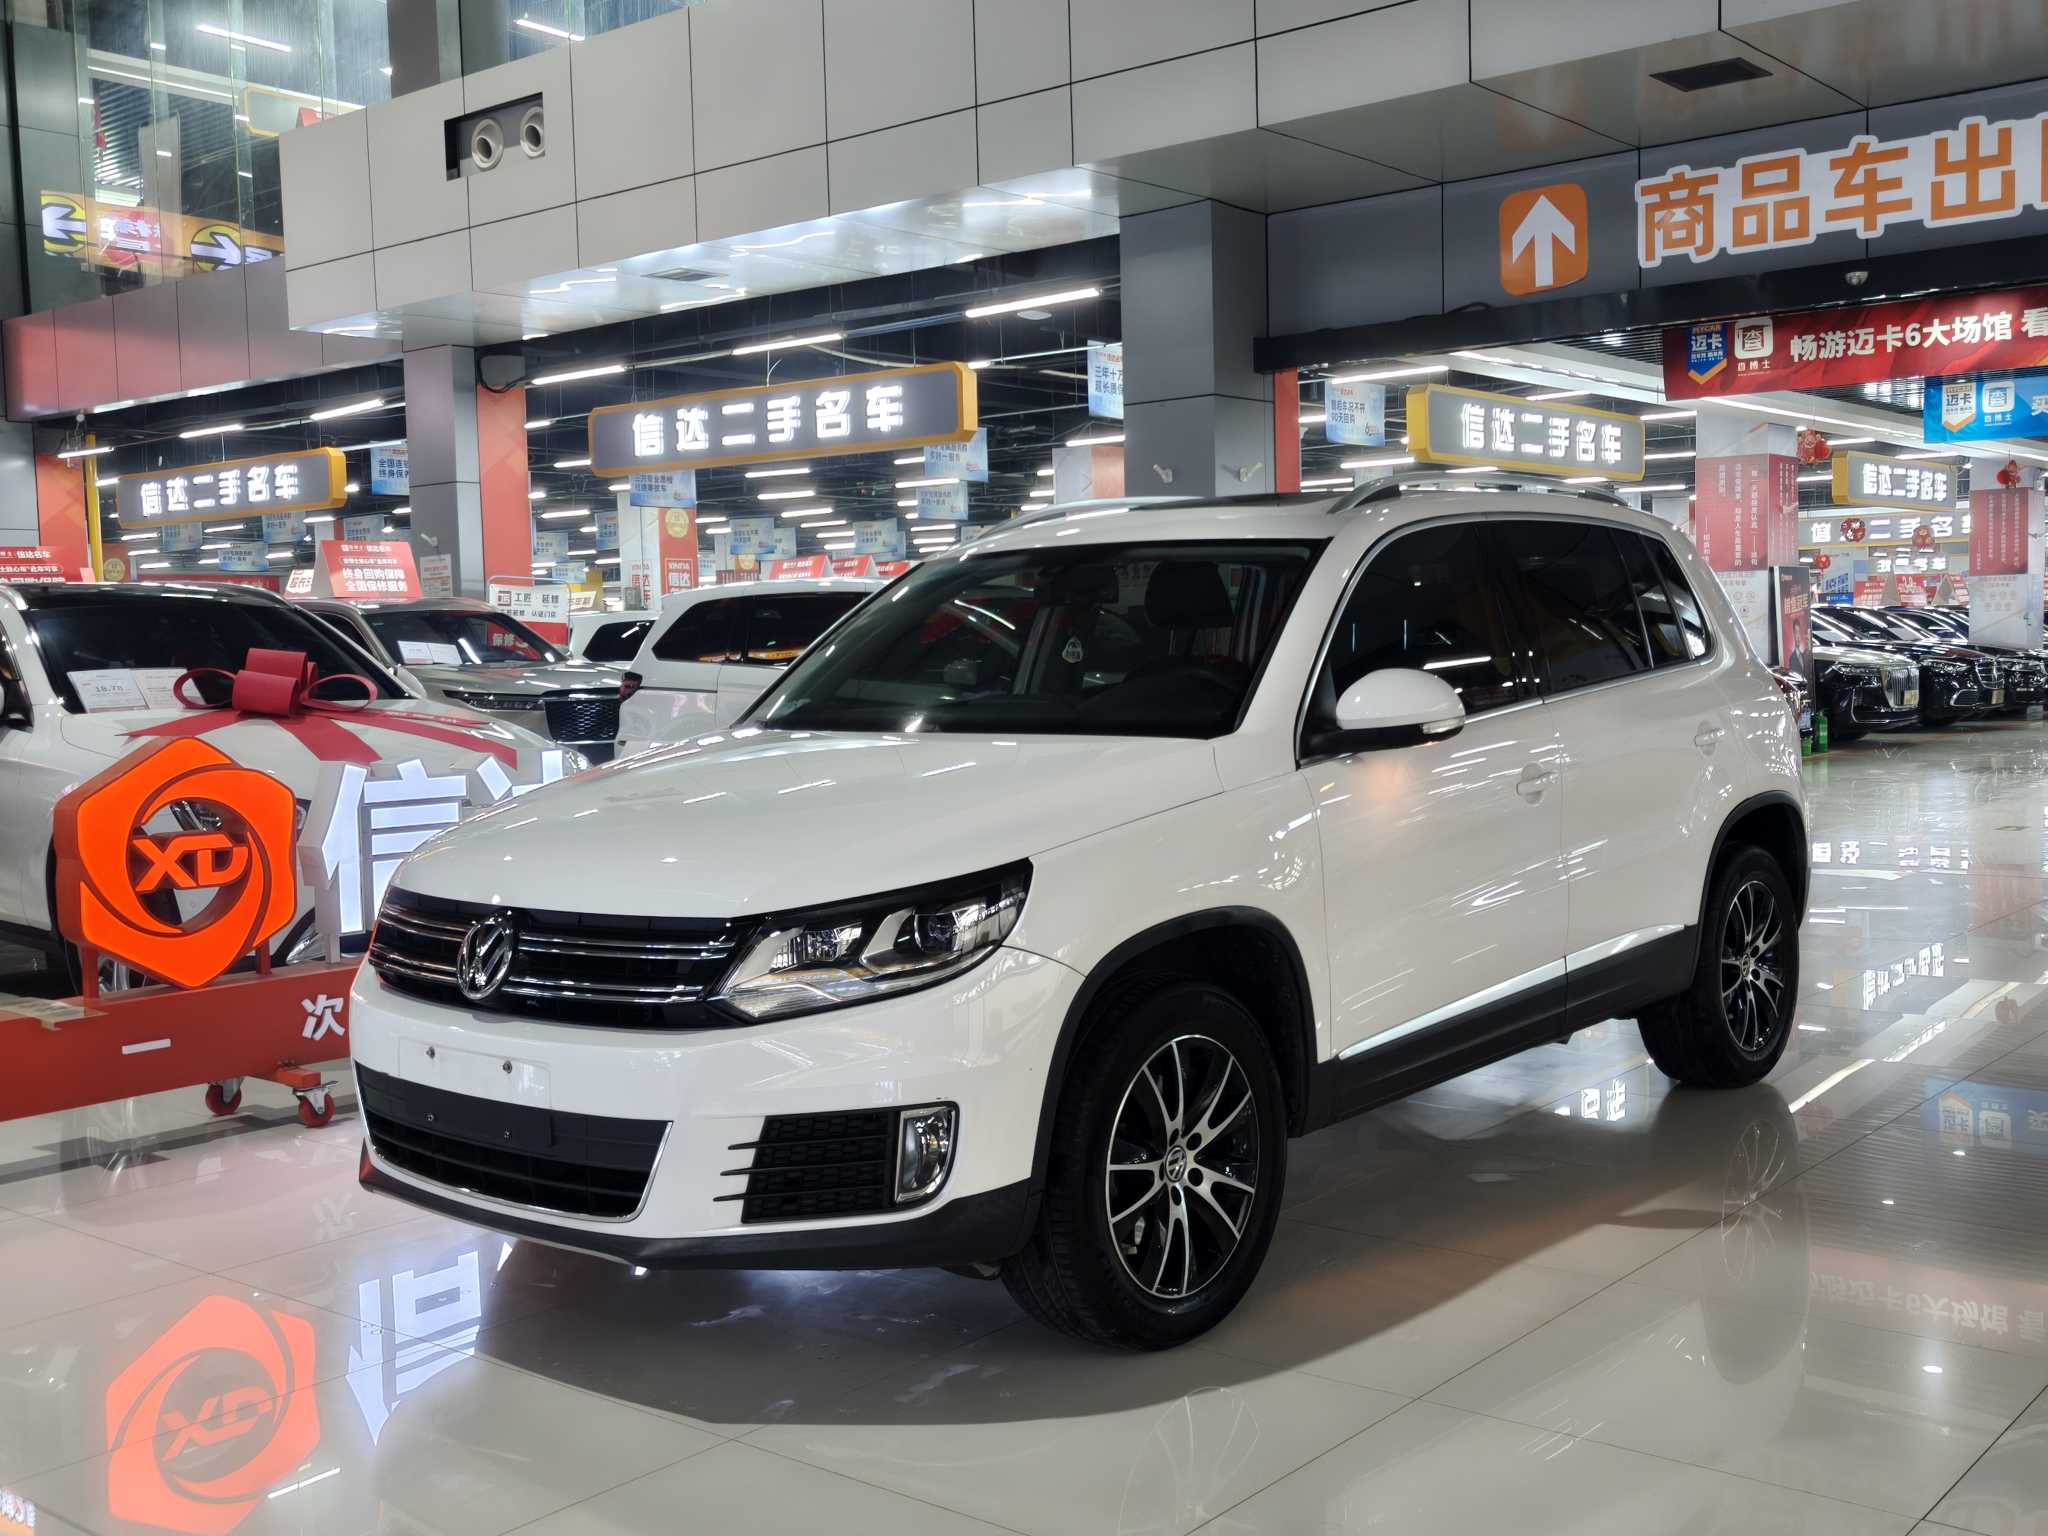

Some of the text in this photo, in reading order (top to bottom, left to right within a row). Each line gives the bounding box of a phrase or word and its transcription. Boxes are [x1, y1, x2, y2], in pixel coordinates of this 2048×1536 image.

[1639, 122, 2048, 263] 商品车出
[1790, 310, 2012, 362] 畅游迈卡6大场馆
[632, 385, 904, 457] 信达二手名车
[1461, 402, 1623, 465] 信达二手名车
[140, 463, 299, 518] 信达二手名车
[1862, 462, 1948, 502] 信达二手名车
[131, 832, 249, 893] XD
[301, 994, 345, 1041] 次
